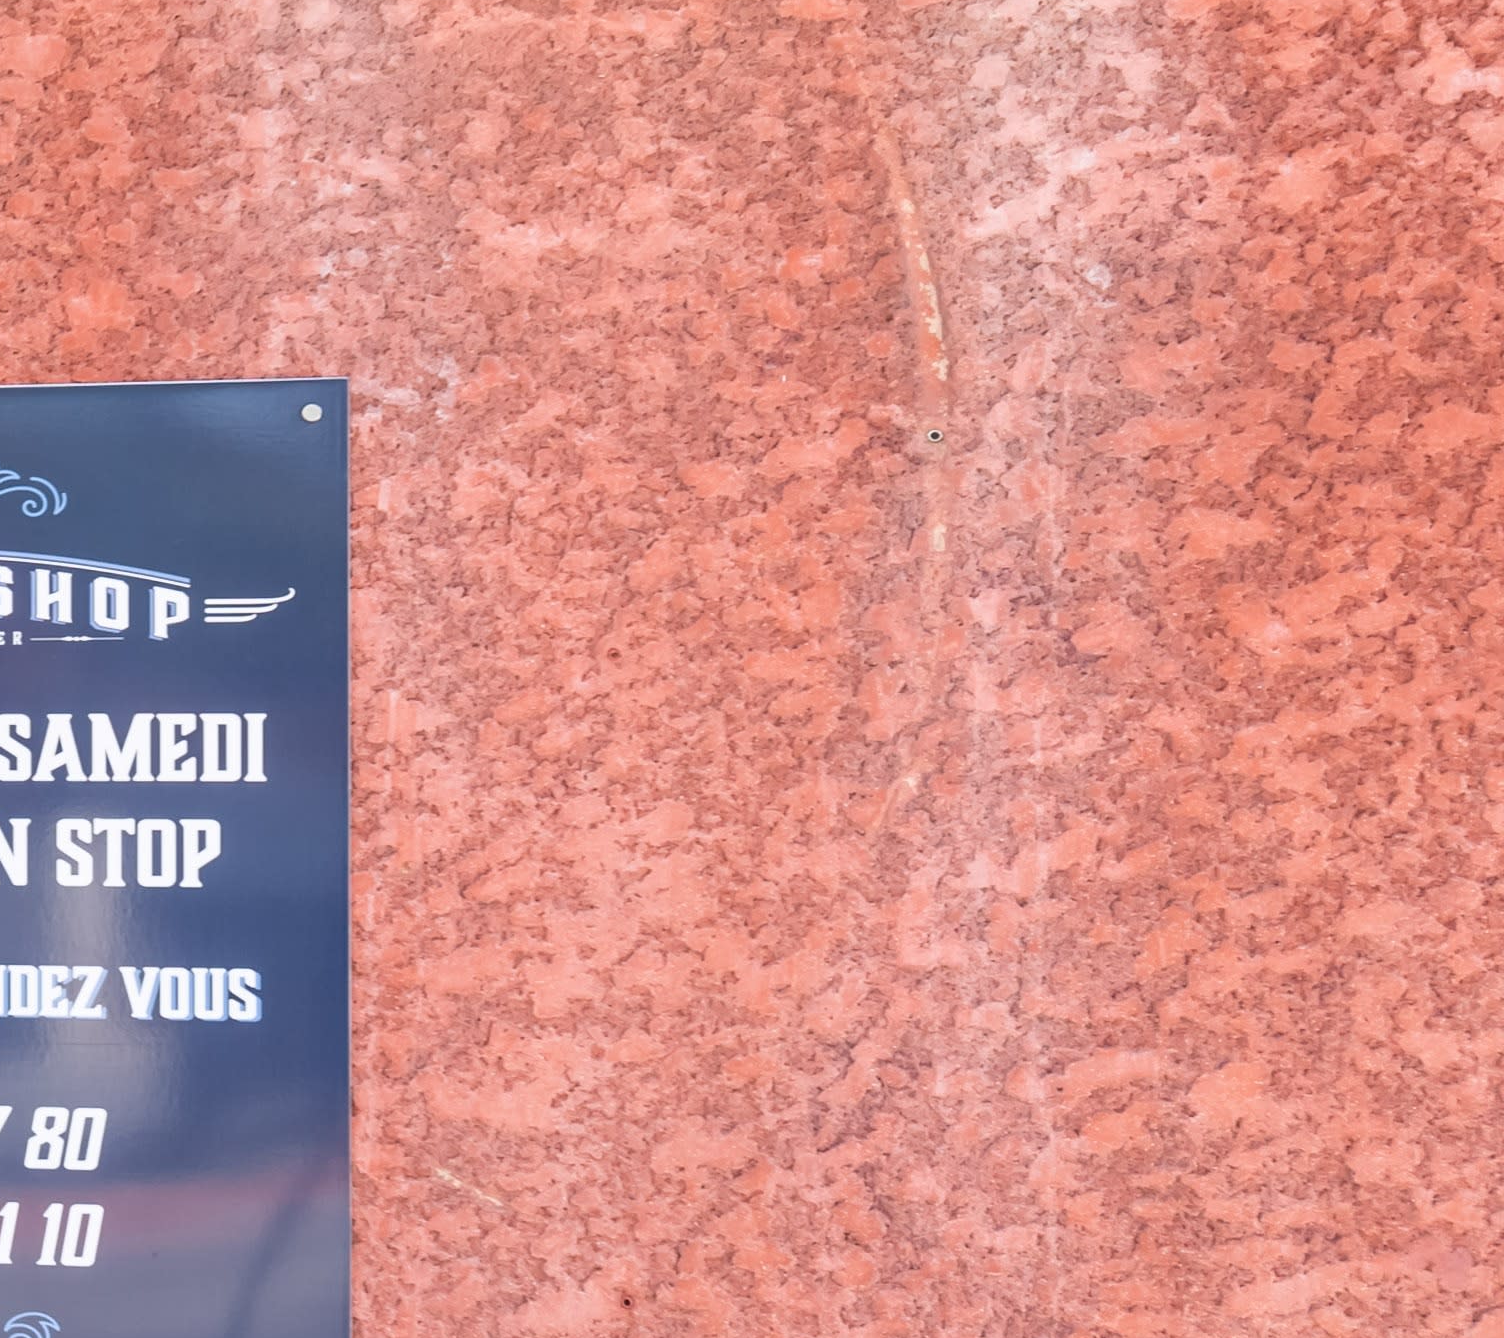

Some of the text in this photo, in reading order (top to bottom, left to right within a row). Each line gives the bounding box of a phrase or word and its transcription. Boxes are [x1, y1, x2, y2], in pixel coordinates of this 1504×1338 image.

[55, 817, 222, 888] STOP
[123, 965, 262, 1022] VOUS
[23, 1106, 109, 1171] 80
[35, 1202, 105, 1267] 10
